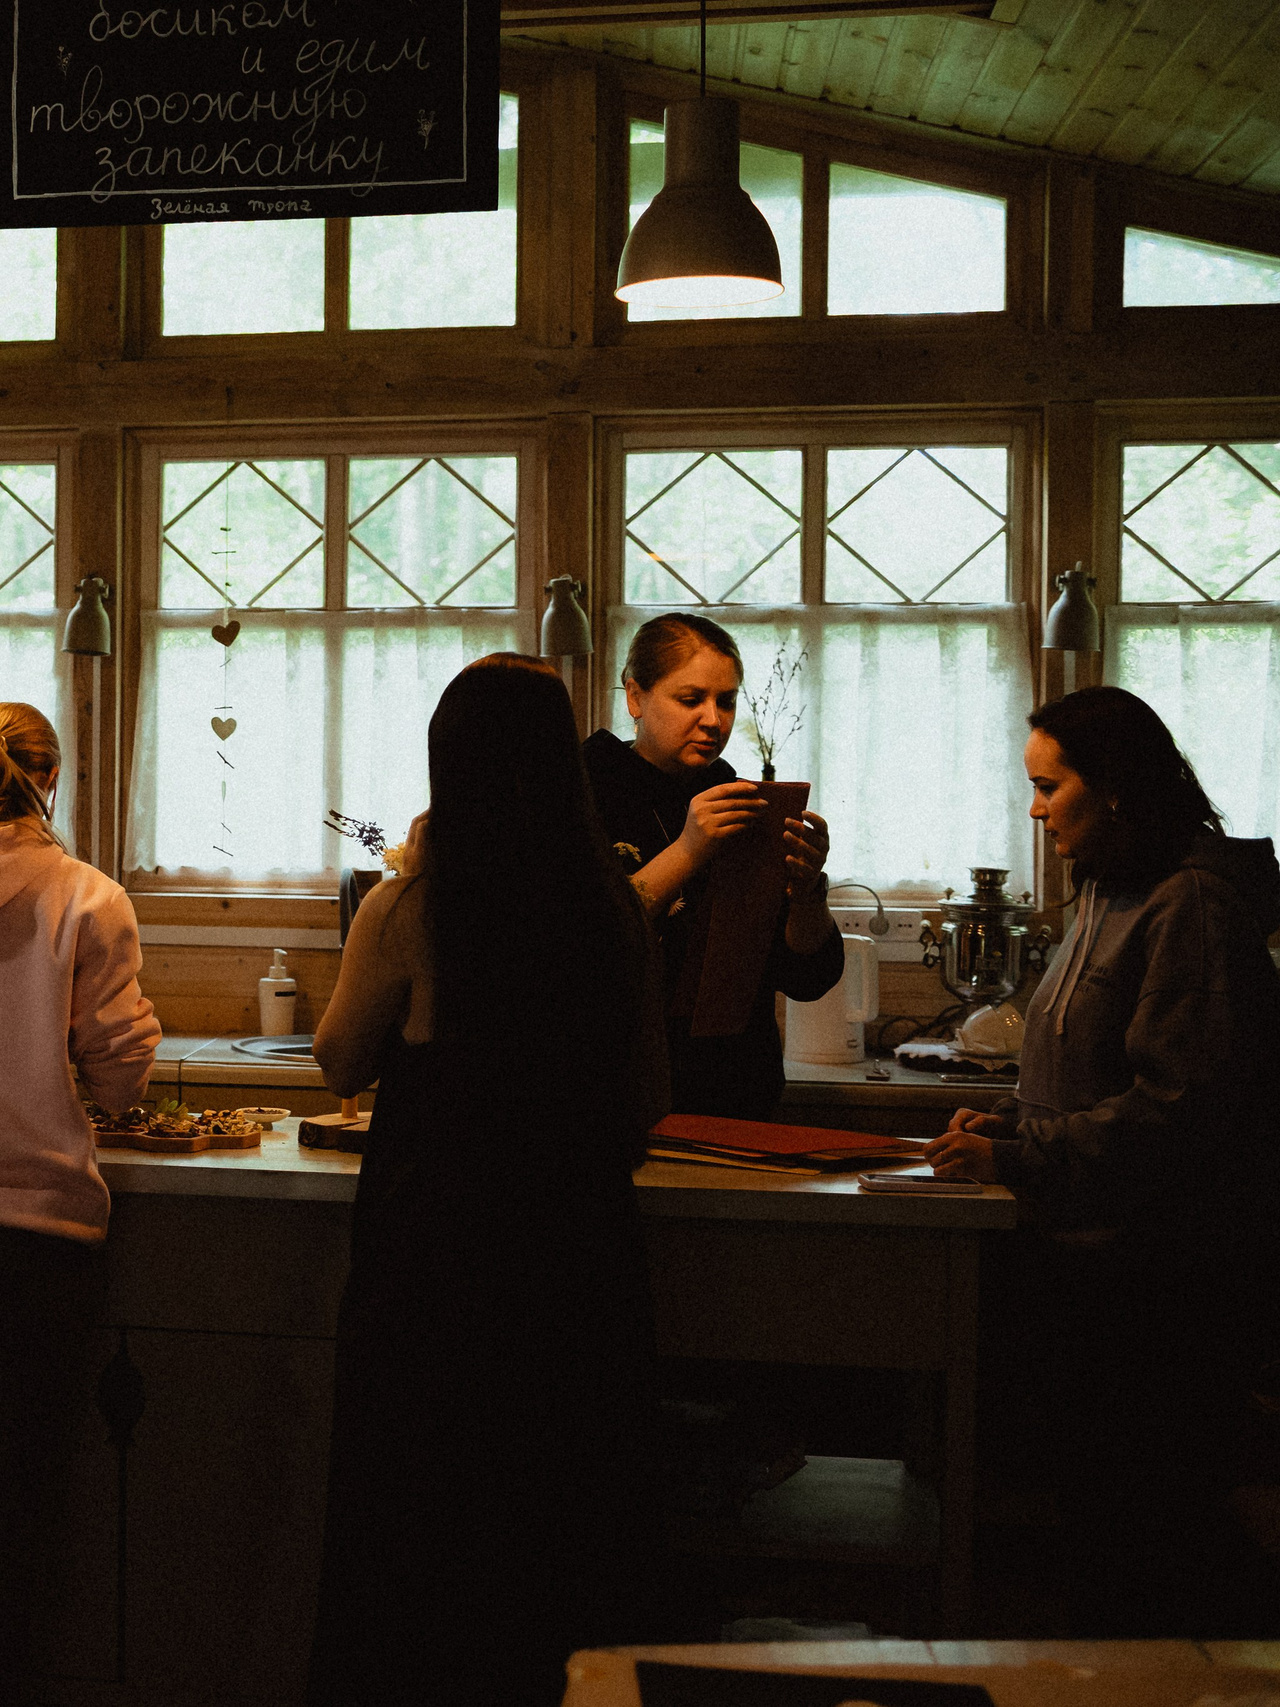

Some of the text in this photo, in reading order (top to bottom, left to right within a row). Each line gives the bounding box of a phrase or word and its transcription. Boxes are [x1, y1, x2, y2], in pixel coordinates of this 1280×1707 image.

[241, 37, 431, 93] и едим
[30, 65, 366, 145] творожную
[90, 136, 389, 204] запеканку
[248, 197, 313, 214] тропа
